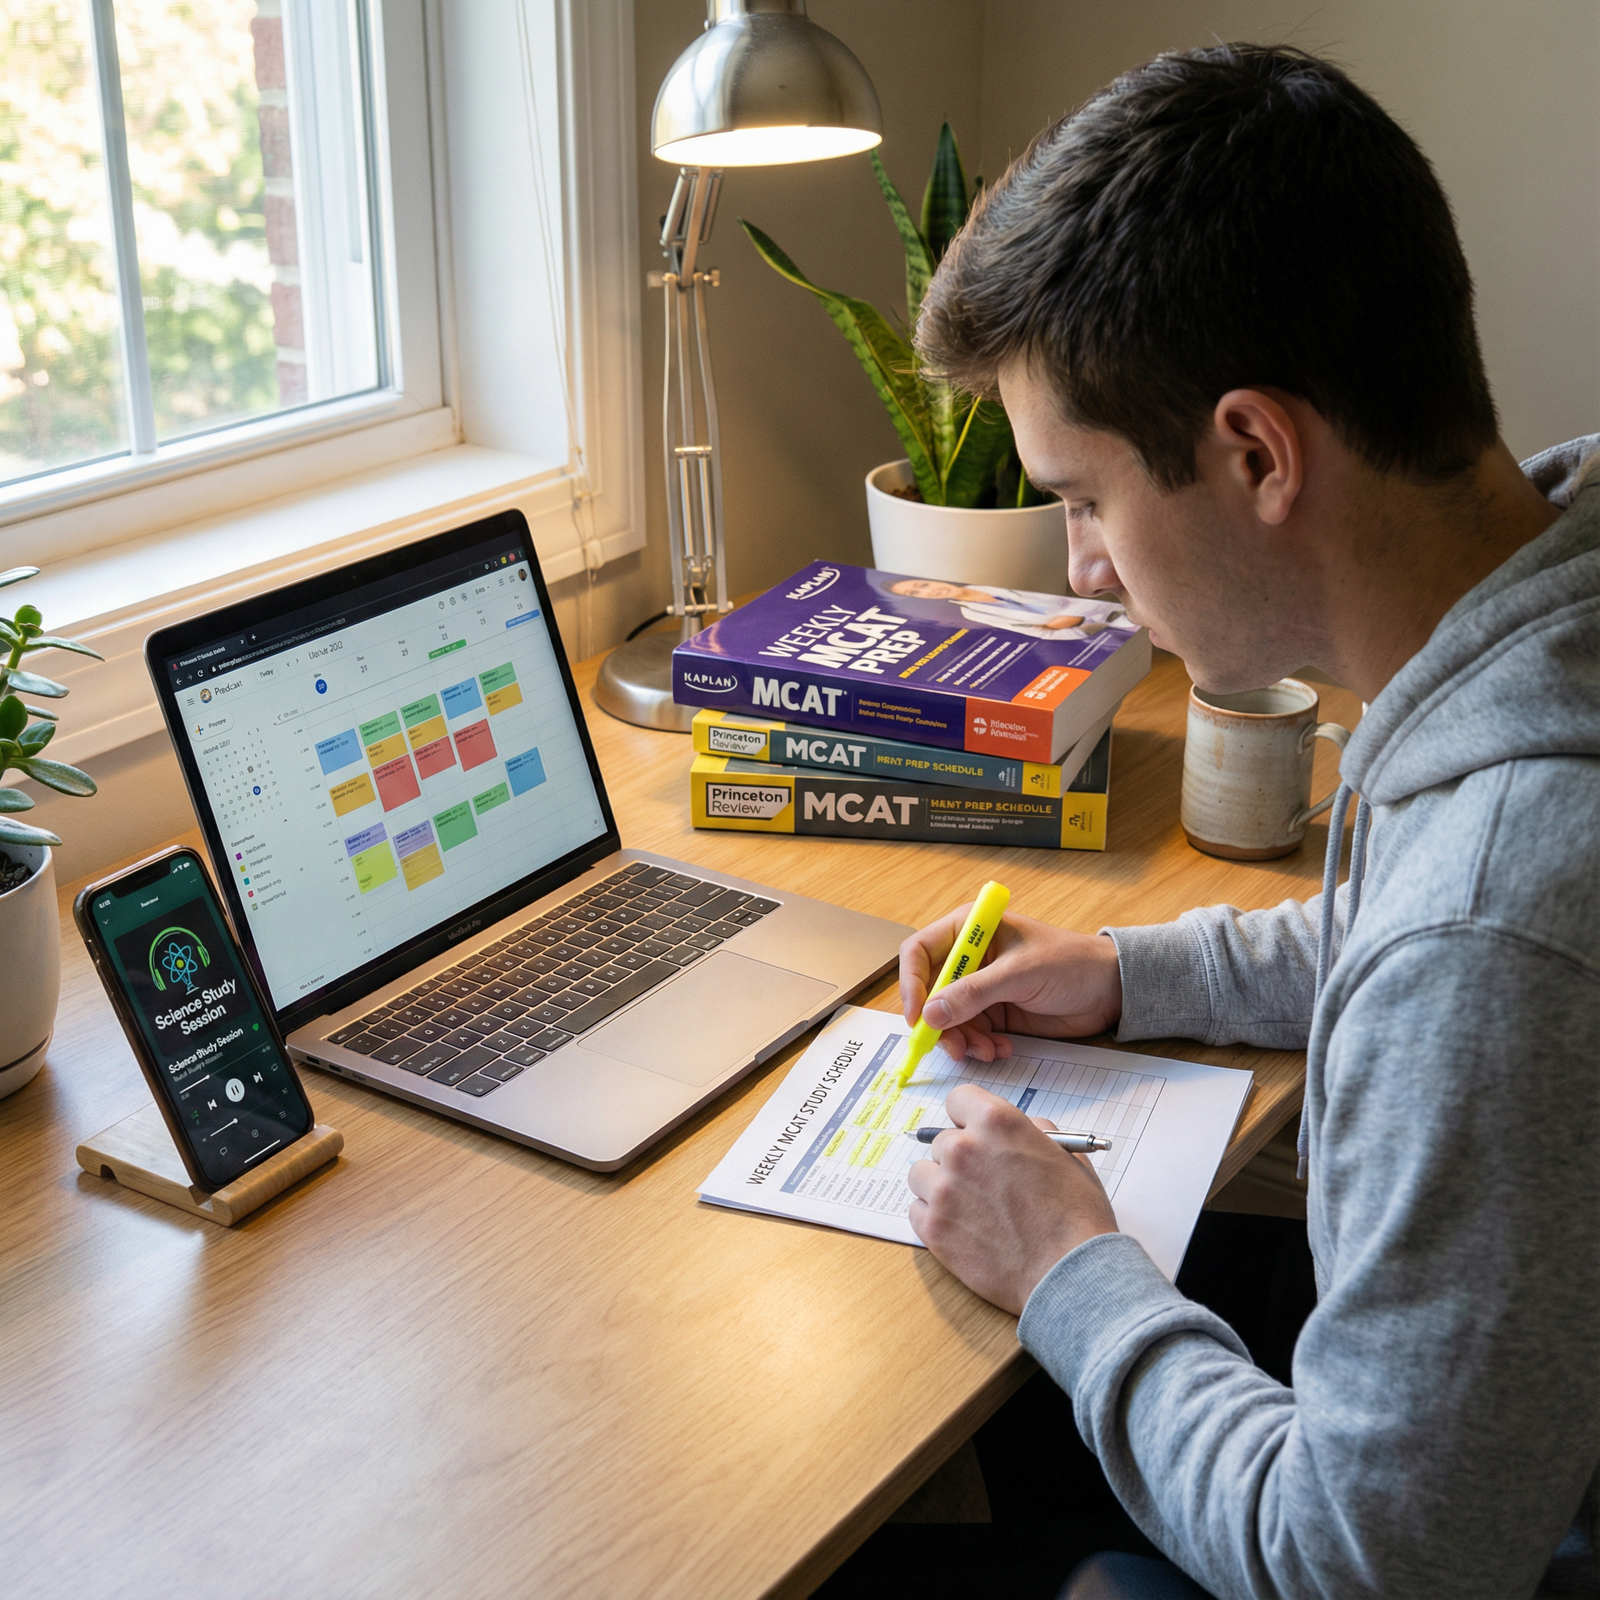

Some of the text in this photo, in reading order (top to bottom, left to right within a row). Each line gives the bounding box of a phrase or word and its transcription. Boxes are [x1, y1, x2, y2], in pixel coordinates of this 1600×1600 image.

[786, 568, 836, 600] KAPLAN
[758, 604, 856, 657] WEEKLY
[797, 606, 908, 669] MCAT
[847, 630, 927, 674] PREP
[684, 672, 733, 688] KAPLAN
[752, 677, 844, 717] MCAT
[712, 730, 761, 744] Princeton
[785, 737, 867, 767] MCAT
[905, 758, 930, 769] PREP
[932, 762, 984, 776] SCHEDULE
[712, 788, 783, 803] Princeton
[804, 791, 919, 826] MCAT
[965, 801, 993, 812] PREP
[995, 803, 1052, 814] SCHEDULE
[155, 978, 236, 1030] Science Study
[180, 1004, 227, 1036] Session
[746, 1144, 787, 1185] WEEKLY
[777, 1113, 809, 1145] MCAT
[799, 1083, 832, 1116] STUDY
[822, 1039, 864, 1085] SCHEDULE
